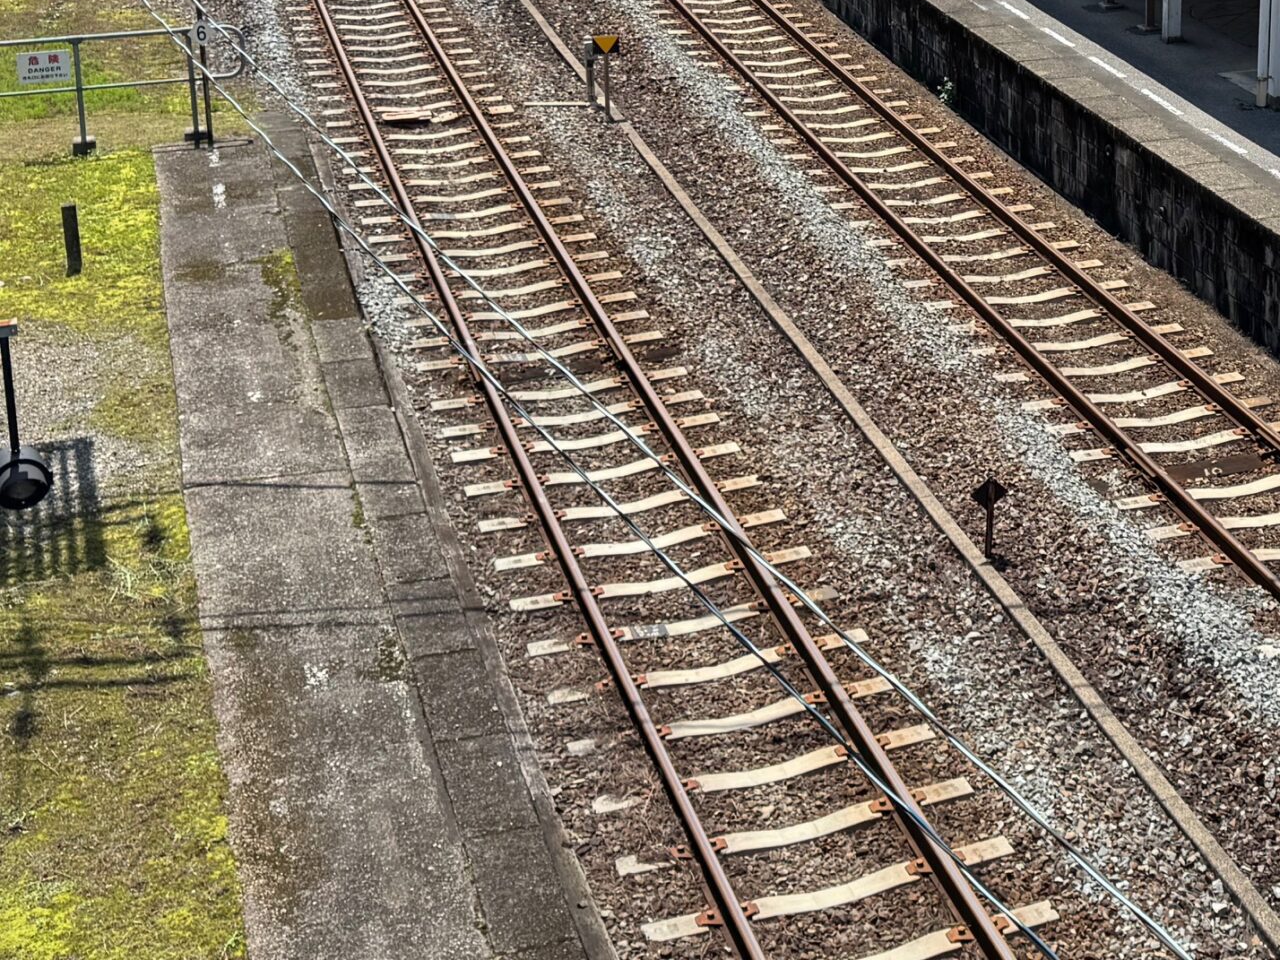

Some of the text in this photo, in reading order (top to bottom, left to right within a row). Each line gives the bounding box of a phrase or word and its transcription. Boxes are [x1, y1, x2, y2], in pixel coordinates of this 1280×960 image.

[196, 25, 207, 41] 6
[28, 54, 60, 66] 危険
[27, 66, 62, 74] DANGER
